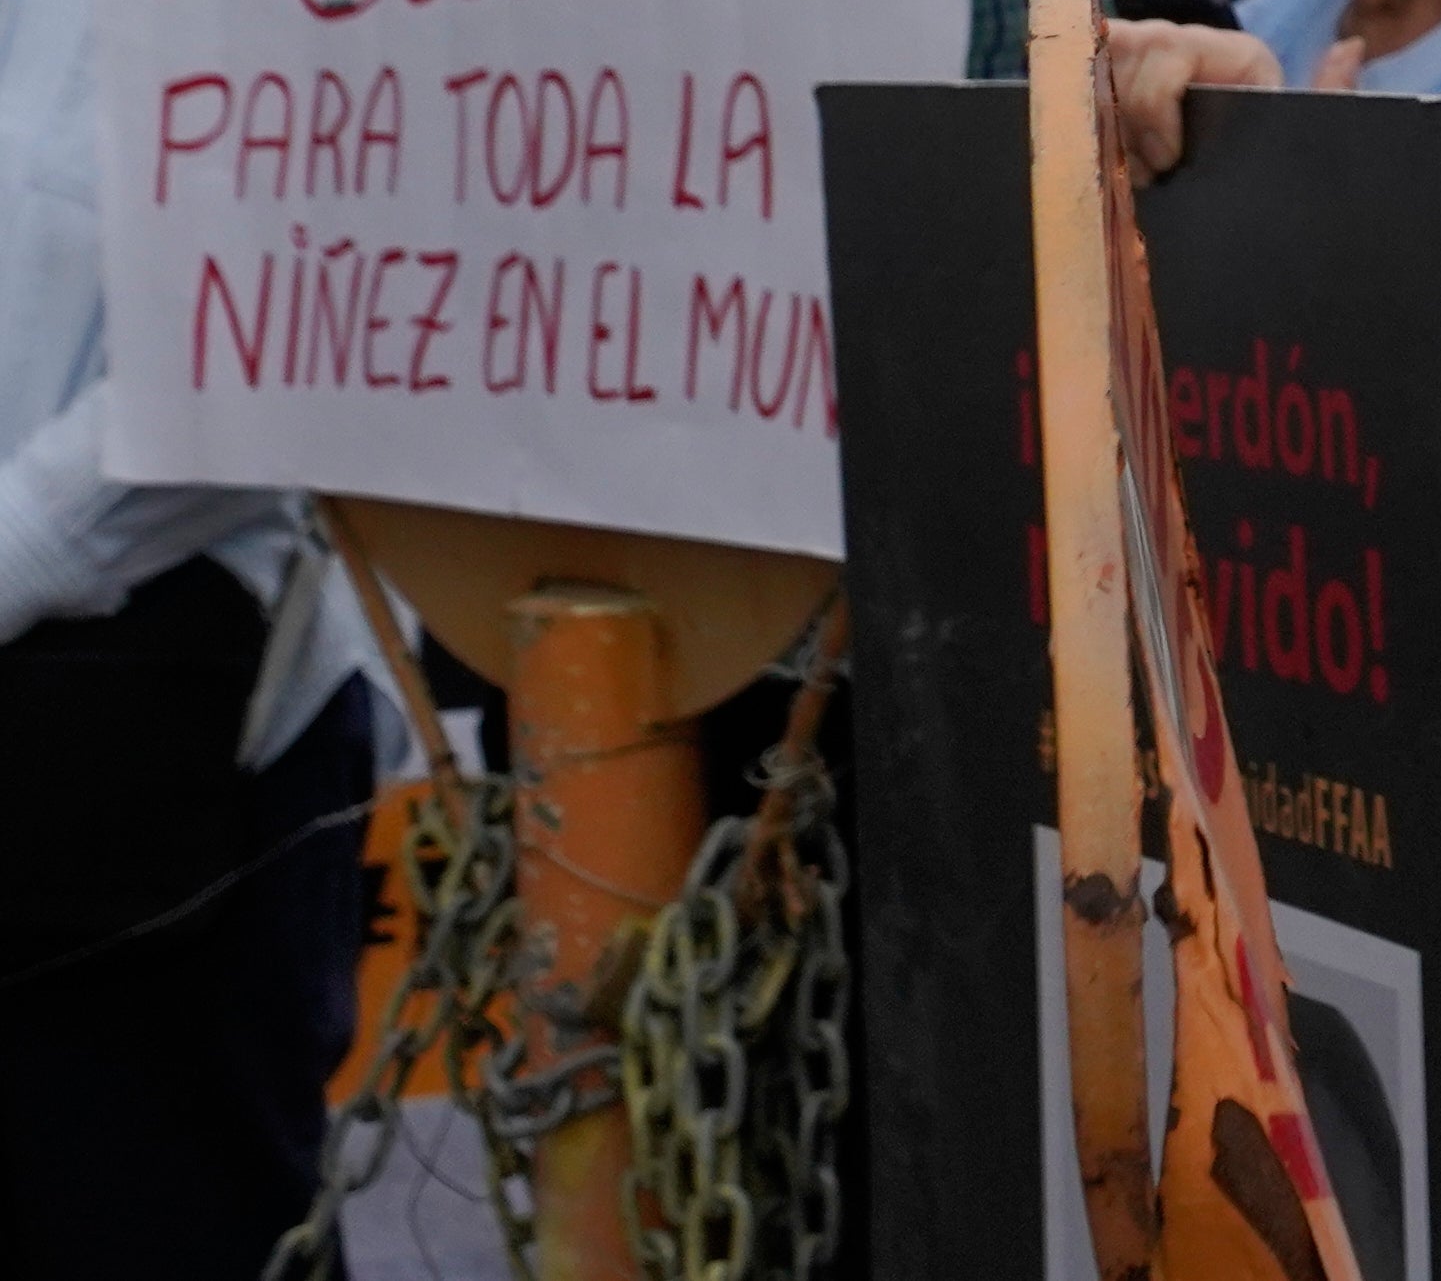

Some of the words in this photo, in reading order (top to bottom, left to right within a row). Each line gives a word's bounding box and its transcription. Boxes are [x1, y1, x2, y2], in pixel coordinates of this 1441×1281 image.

[156, 67, 402, 207] PARA
[444, 67, 632, 211] TODA
[672, 71, 776, 219] LA
[480, 251, 566, 395] EN
[588, 261, 658, 403] EL
[1168, 339, 1386, 507] erdón,
